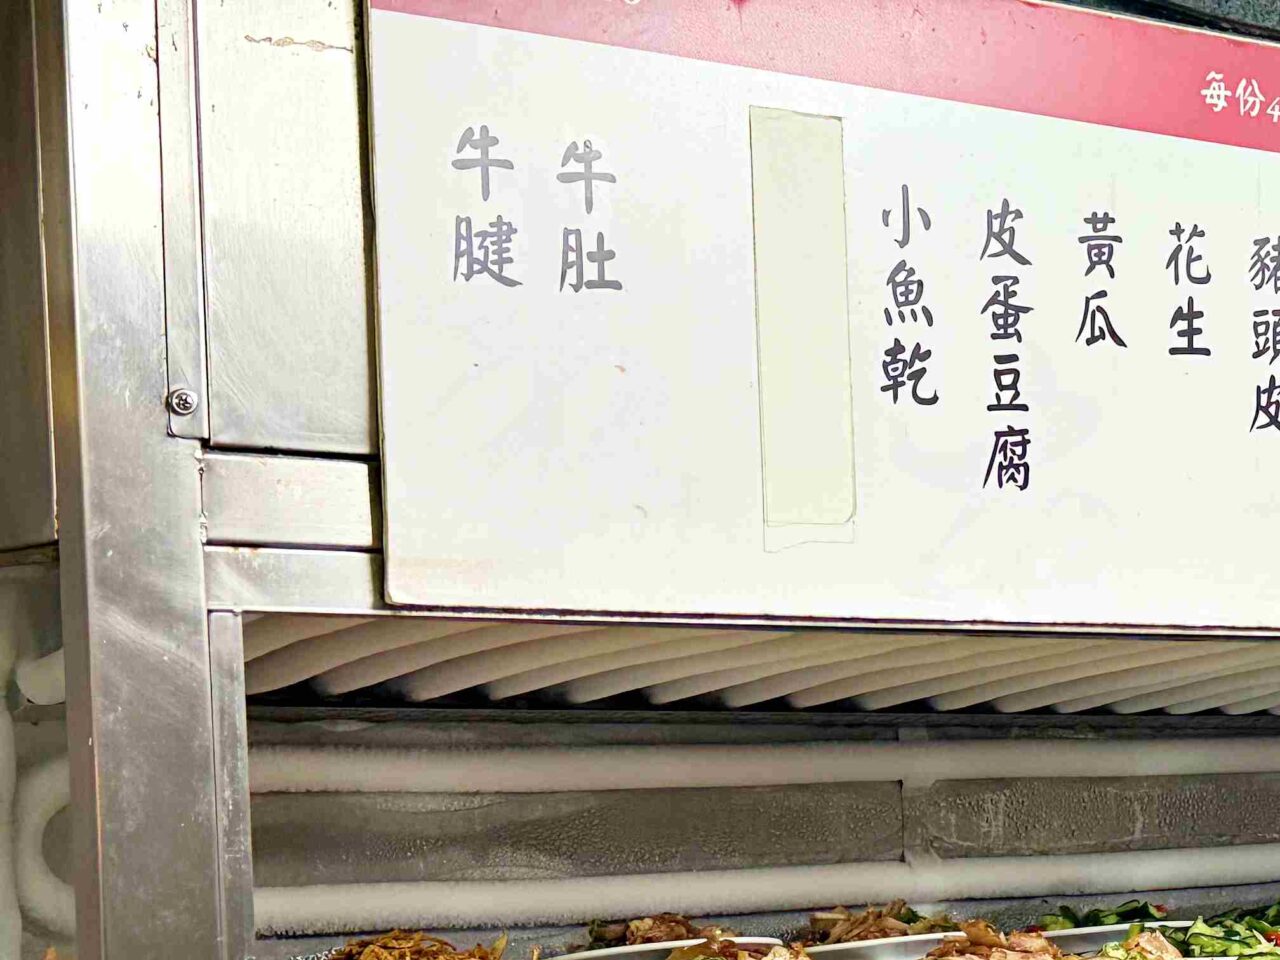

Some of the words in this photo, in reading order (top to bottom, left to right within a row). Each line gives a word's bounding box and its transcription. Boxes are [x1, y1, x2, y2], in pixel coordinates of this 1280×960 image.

[452, 125, 525, 289] 牛腱
[556, 139, 624, 293] 牛肚
[1075, 211, 1128, 349] 黃瓜
[880, 184, 940, 406] 小魚乾
[980, 198, 1035, 492] 皮蛋豆腐
[1166, 221, 1212, 357] 花生
